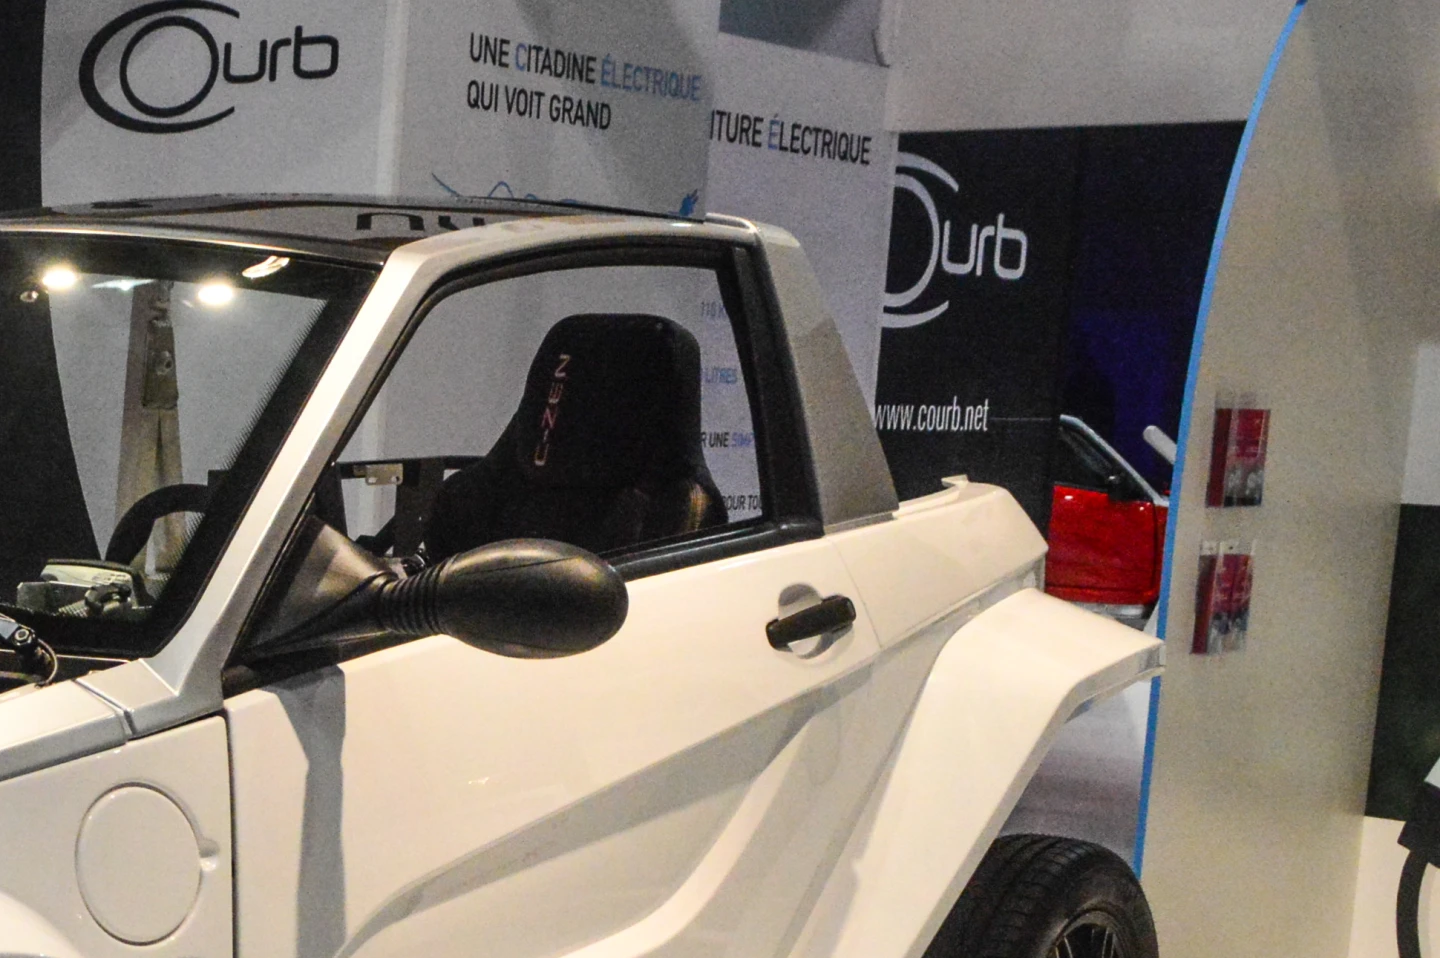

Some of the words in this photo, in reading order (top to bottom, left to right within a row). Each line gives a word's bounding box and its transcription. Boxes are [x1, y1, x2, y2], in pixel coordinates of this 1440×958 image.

[469, 32, 510, 68] UNE
[515, 43, 596, 84] CITADINE
[601, 53, 702, 101] ÉLECTRIQUE
[467, 80, 499, 112] QUI
[505, 85, 545, 119] VOIT
[549, 94, 611, 130] GRAND
[768, 113, 872, 165] ÉLECTRIQUE
[874, 395, 989, 433] www.courb.net
